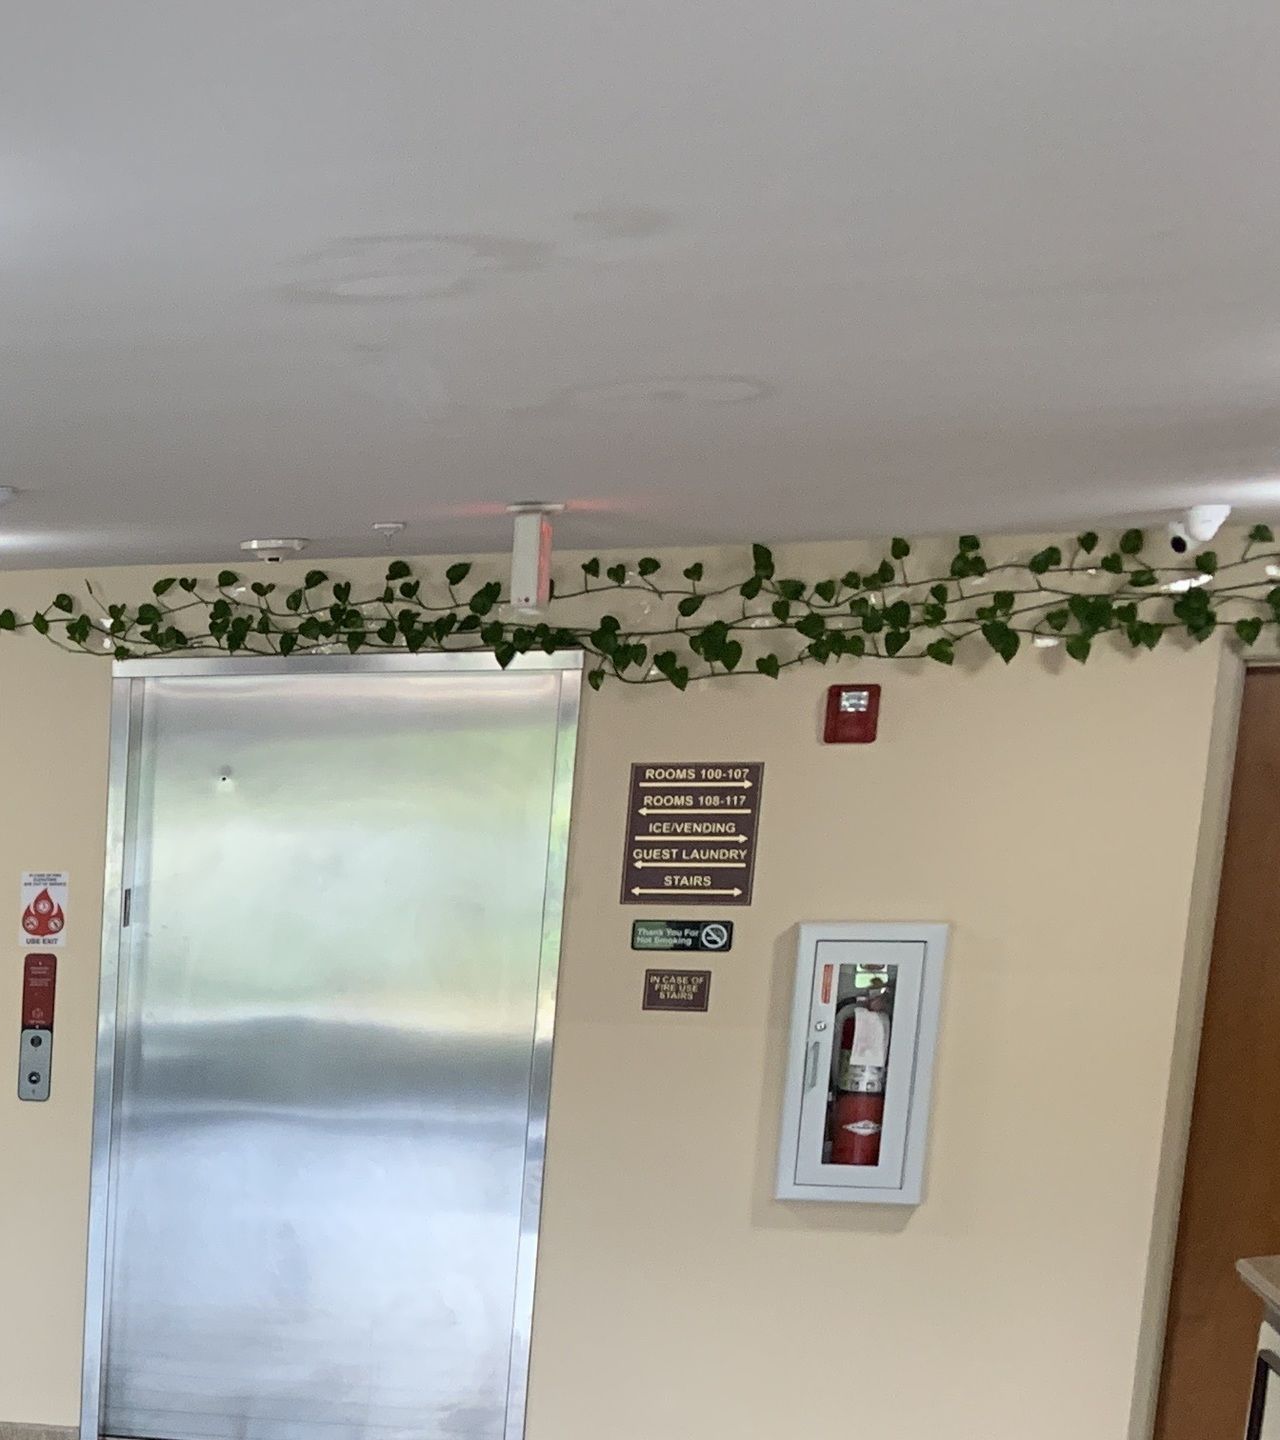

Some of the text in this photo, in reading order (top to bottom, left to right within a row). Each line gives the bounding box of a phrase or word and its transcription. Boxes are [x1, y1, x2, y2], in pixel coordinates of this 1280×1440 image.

[645, 768, 750, 780] ROOMS 100-107
[643, 795, 747, 807] ROOMS 108-117
[648, 822, 736, 834] ICE/VENDING
[632, 848, 748, 860] GUEST LAUNDRY
[663, 875, 712, 887] STAIRS
[637, 928, 699, 937] Thank You For
[636, 936, 692, 947] Not Smoking
[650, 975, 704, 985] IN CASE OF
[654, 983, 699, 993] FIRE USE
[659, 991, 694, 1000] STAIRS
